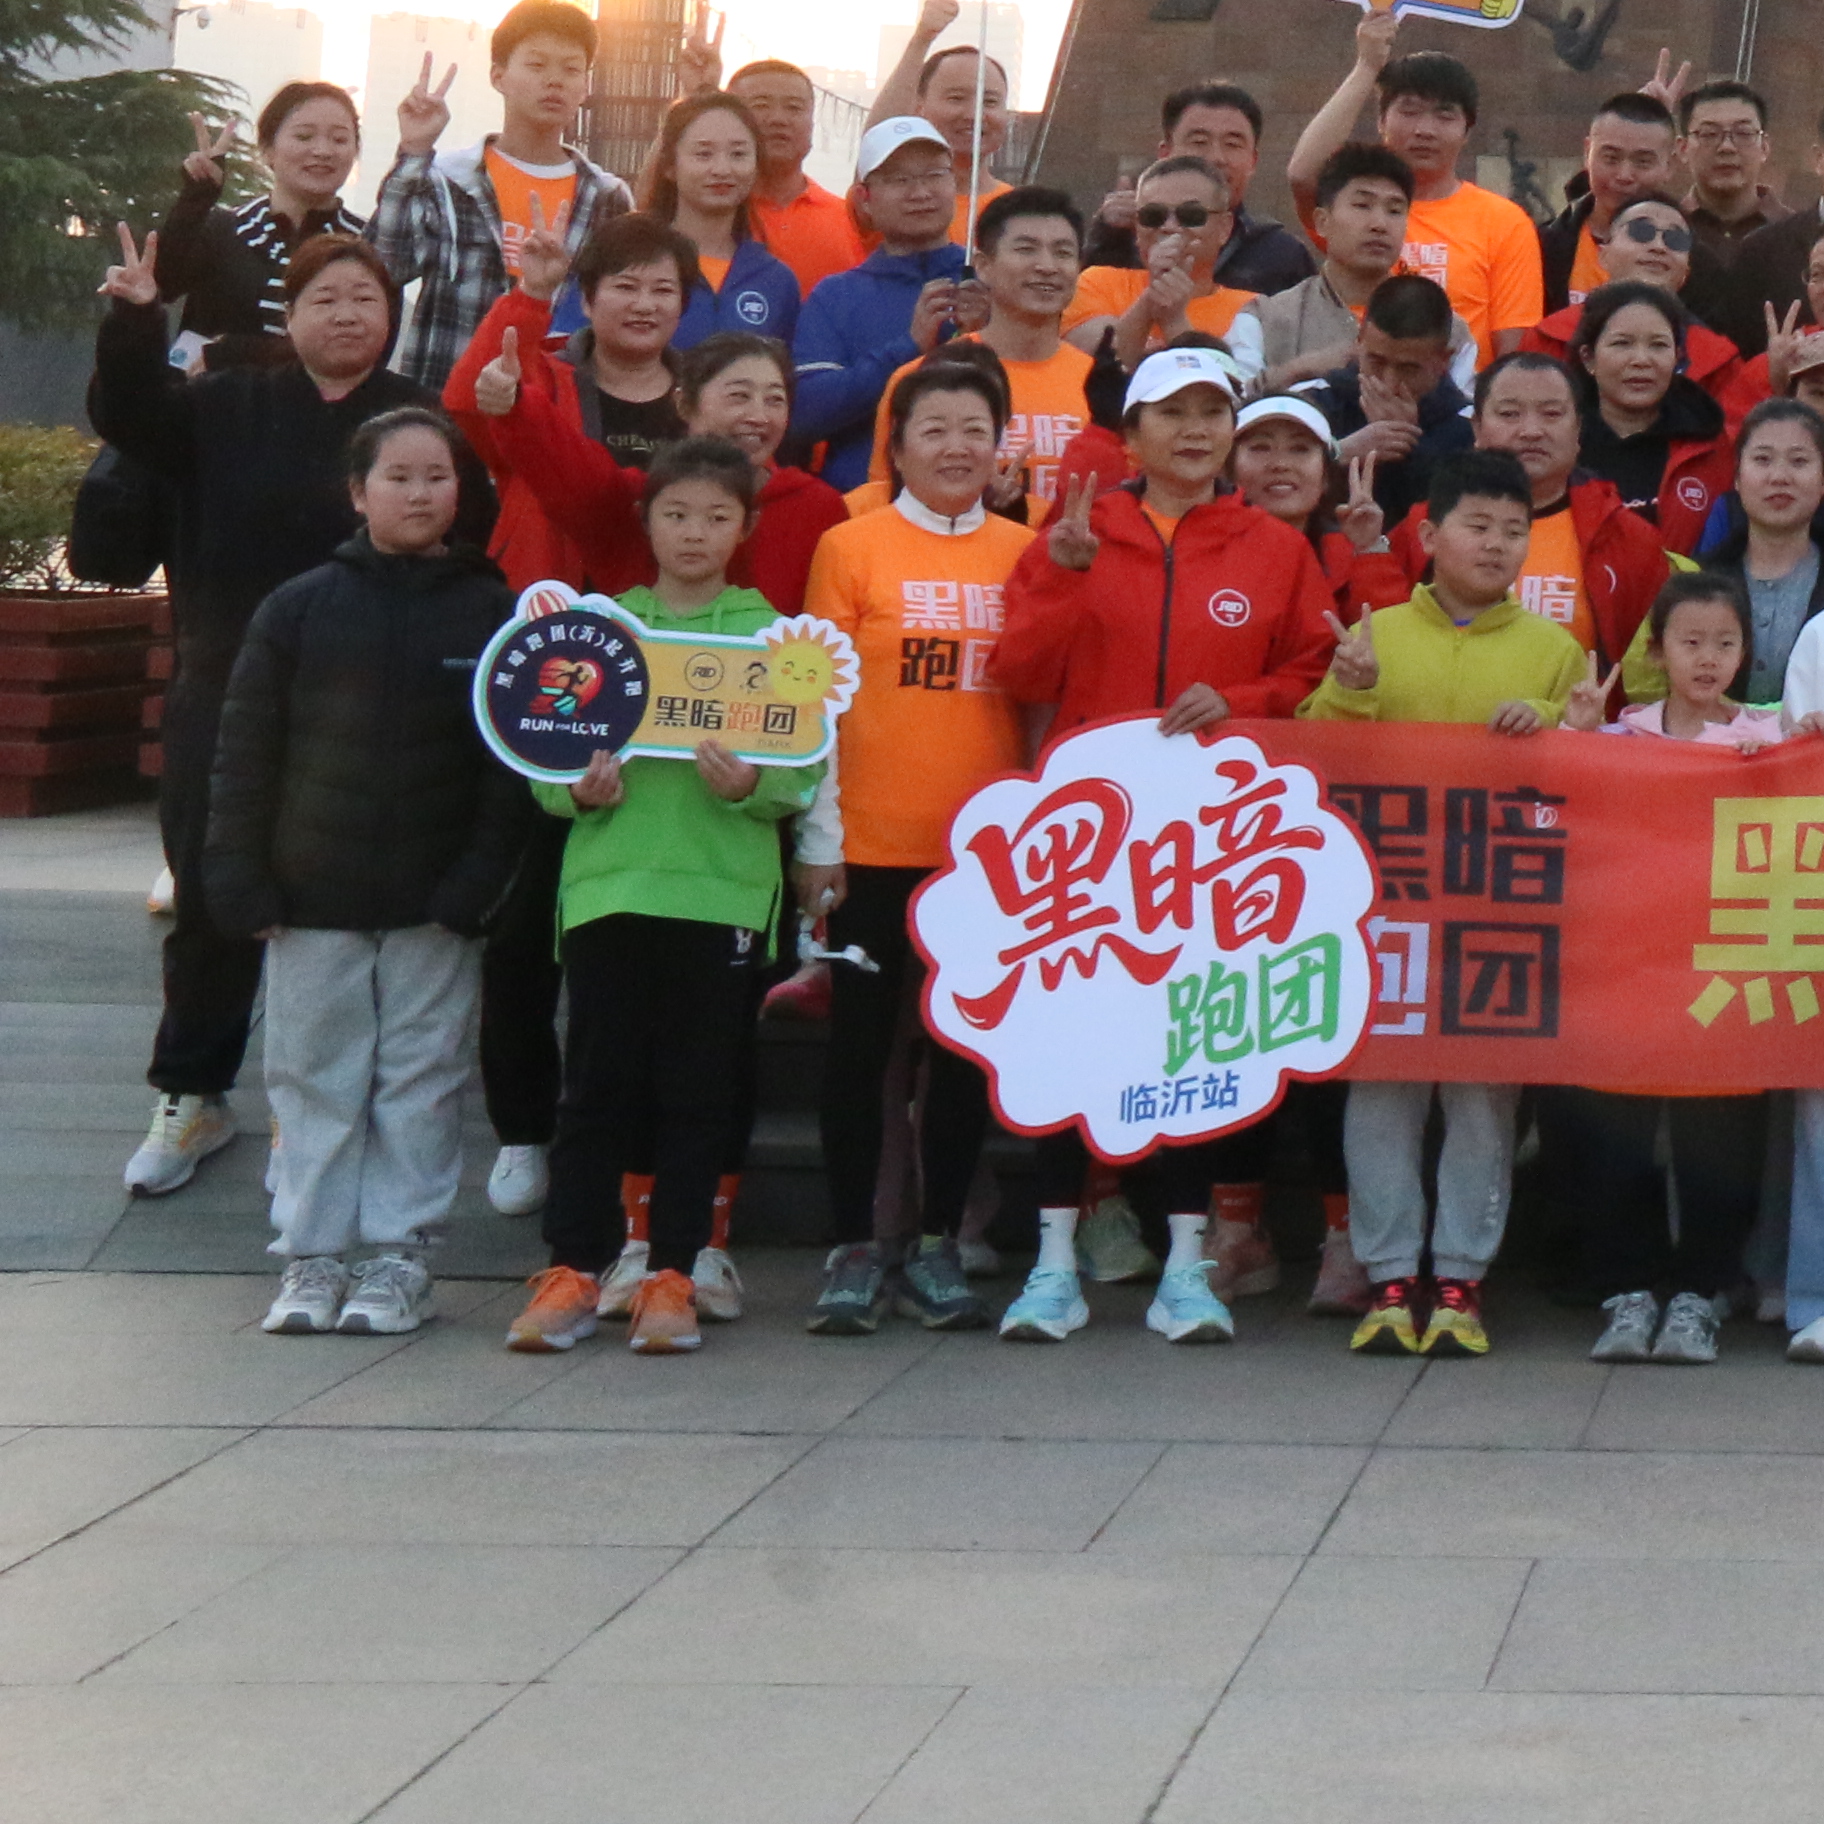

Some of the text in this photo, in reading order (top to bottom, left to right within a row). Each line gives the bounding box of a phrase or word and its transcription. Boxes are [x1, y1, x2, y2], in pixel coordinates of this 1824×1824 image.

[519, 717, 554, 732] RUN
[655, 695, 797, 735] 黑暗跑团
[951, 758, 1326, 1033] 黑暗
[1162, 931, 1343, 1078] 跑团
[1120, 1069, 1241, 1125] 临沂站
